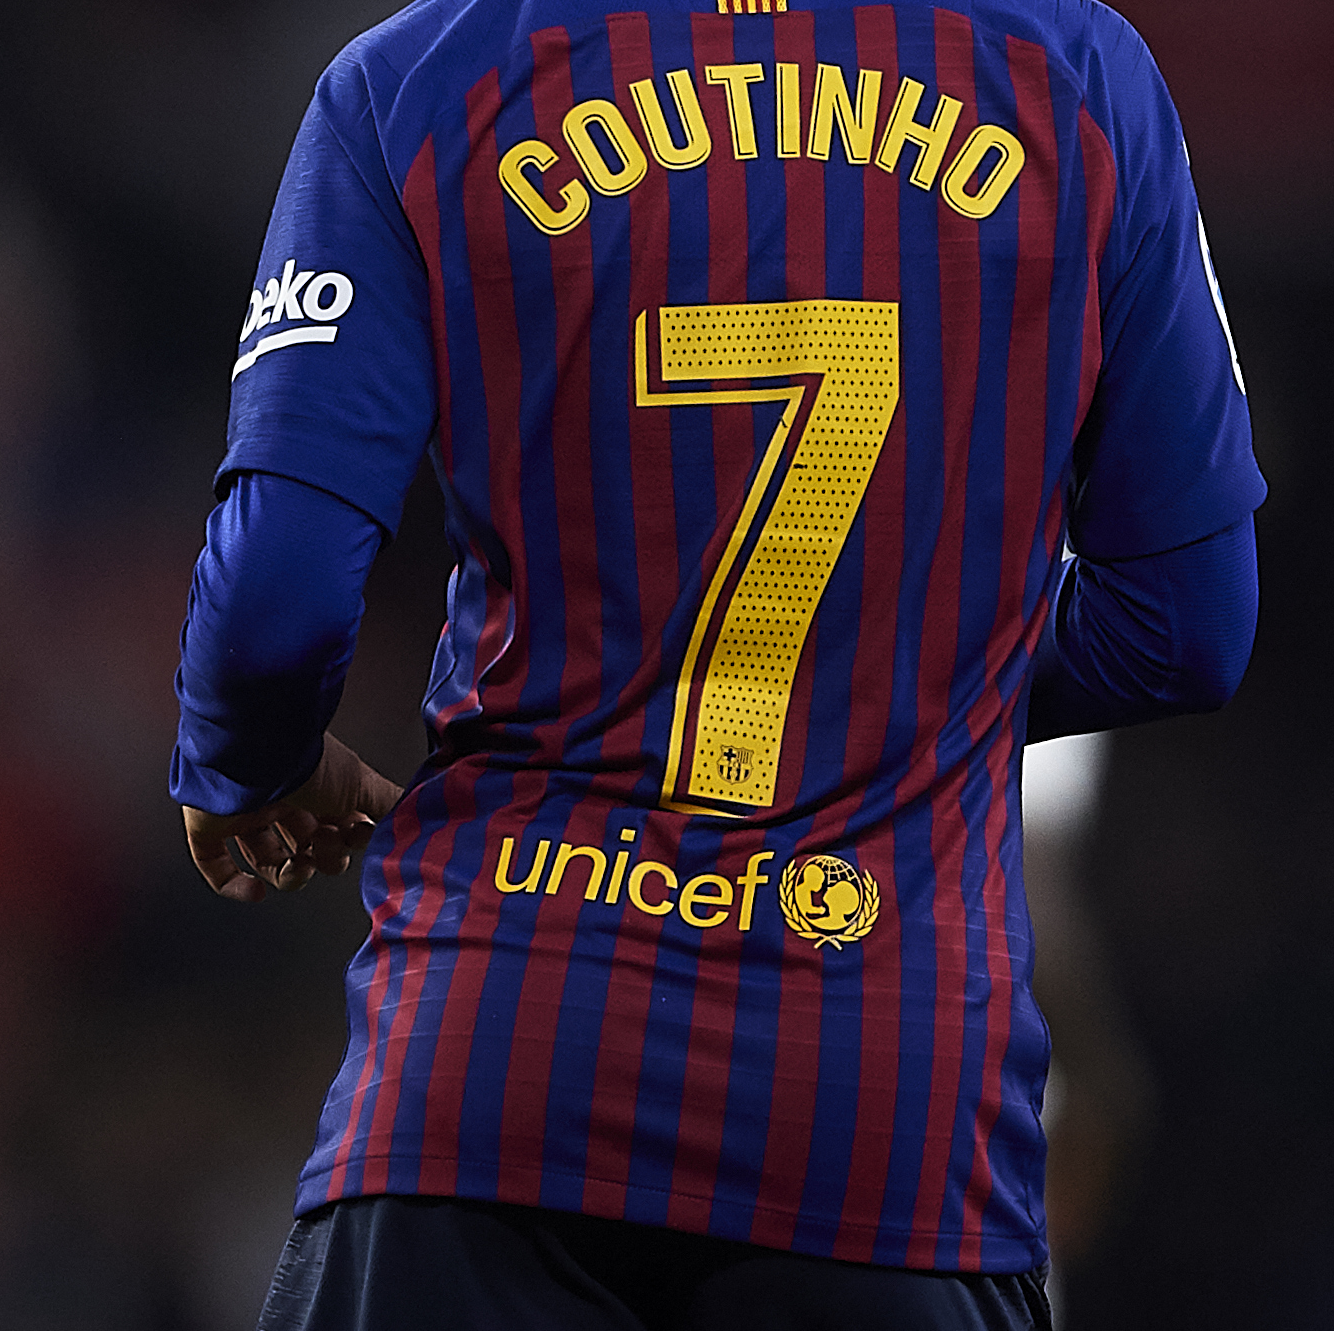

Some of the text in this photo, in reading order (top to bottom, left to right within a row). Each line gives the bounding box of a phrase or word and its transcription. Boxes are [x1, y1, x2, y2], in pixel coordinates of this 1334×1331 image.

[498, 63, 1026, 236] COUTINHO
[635, 299, 900, 819] 7
[494, 828, 775, 932] unicef
